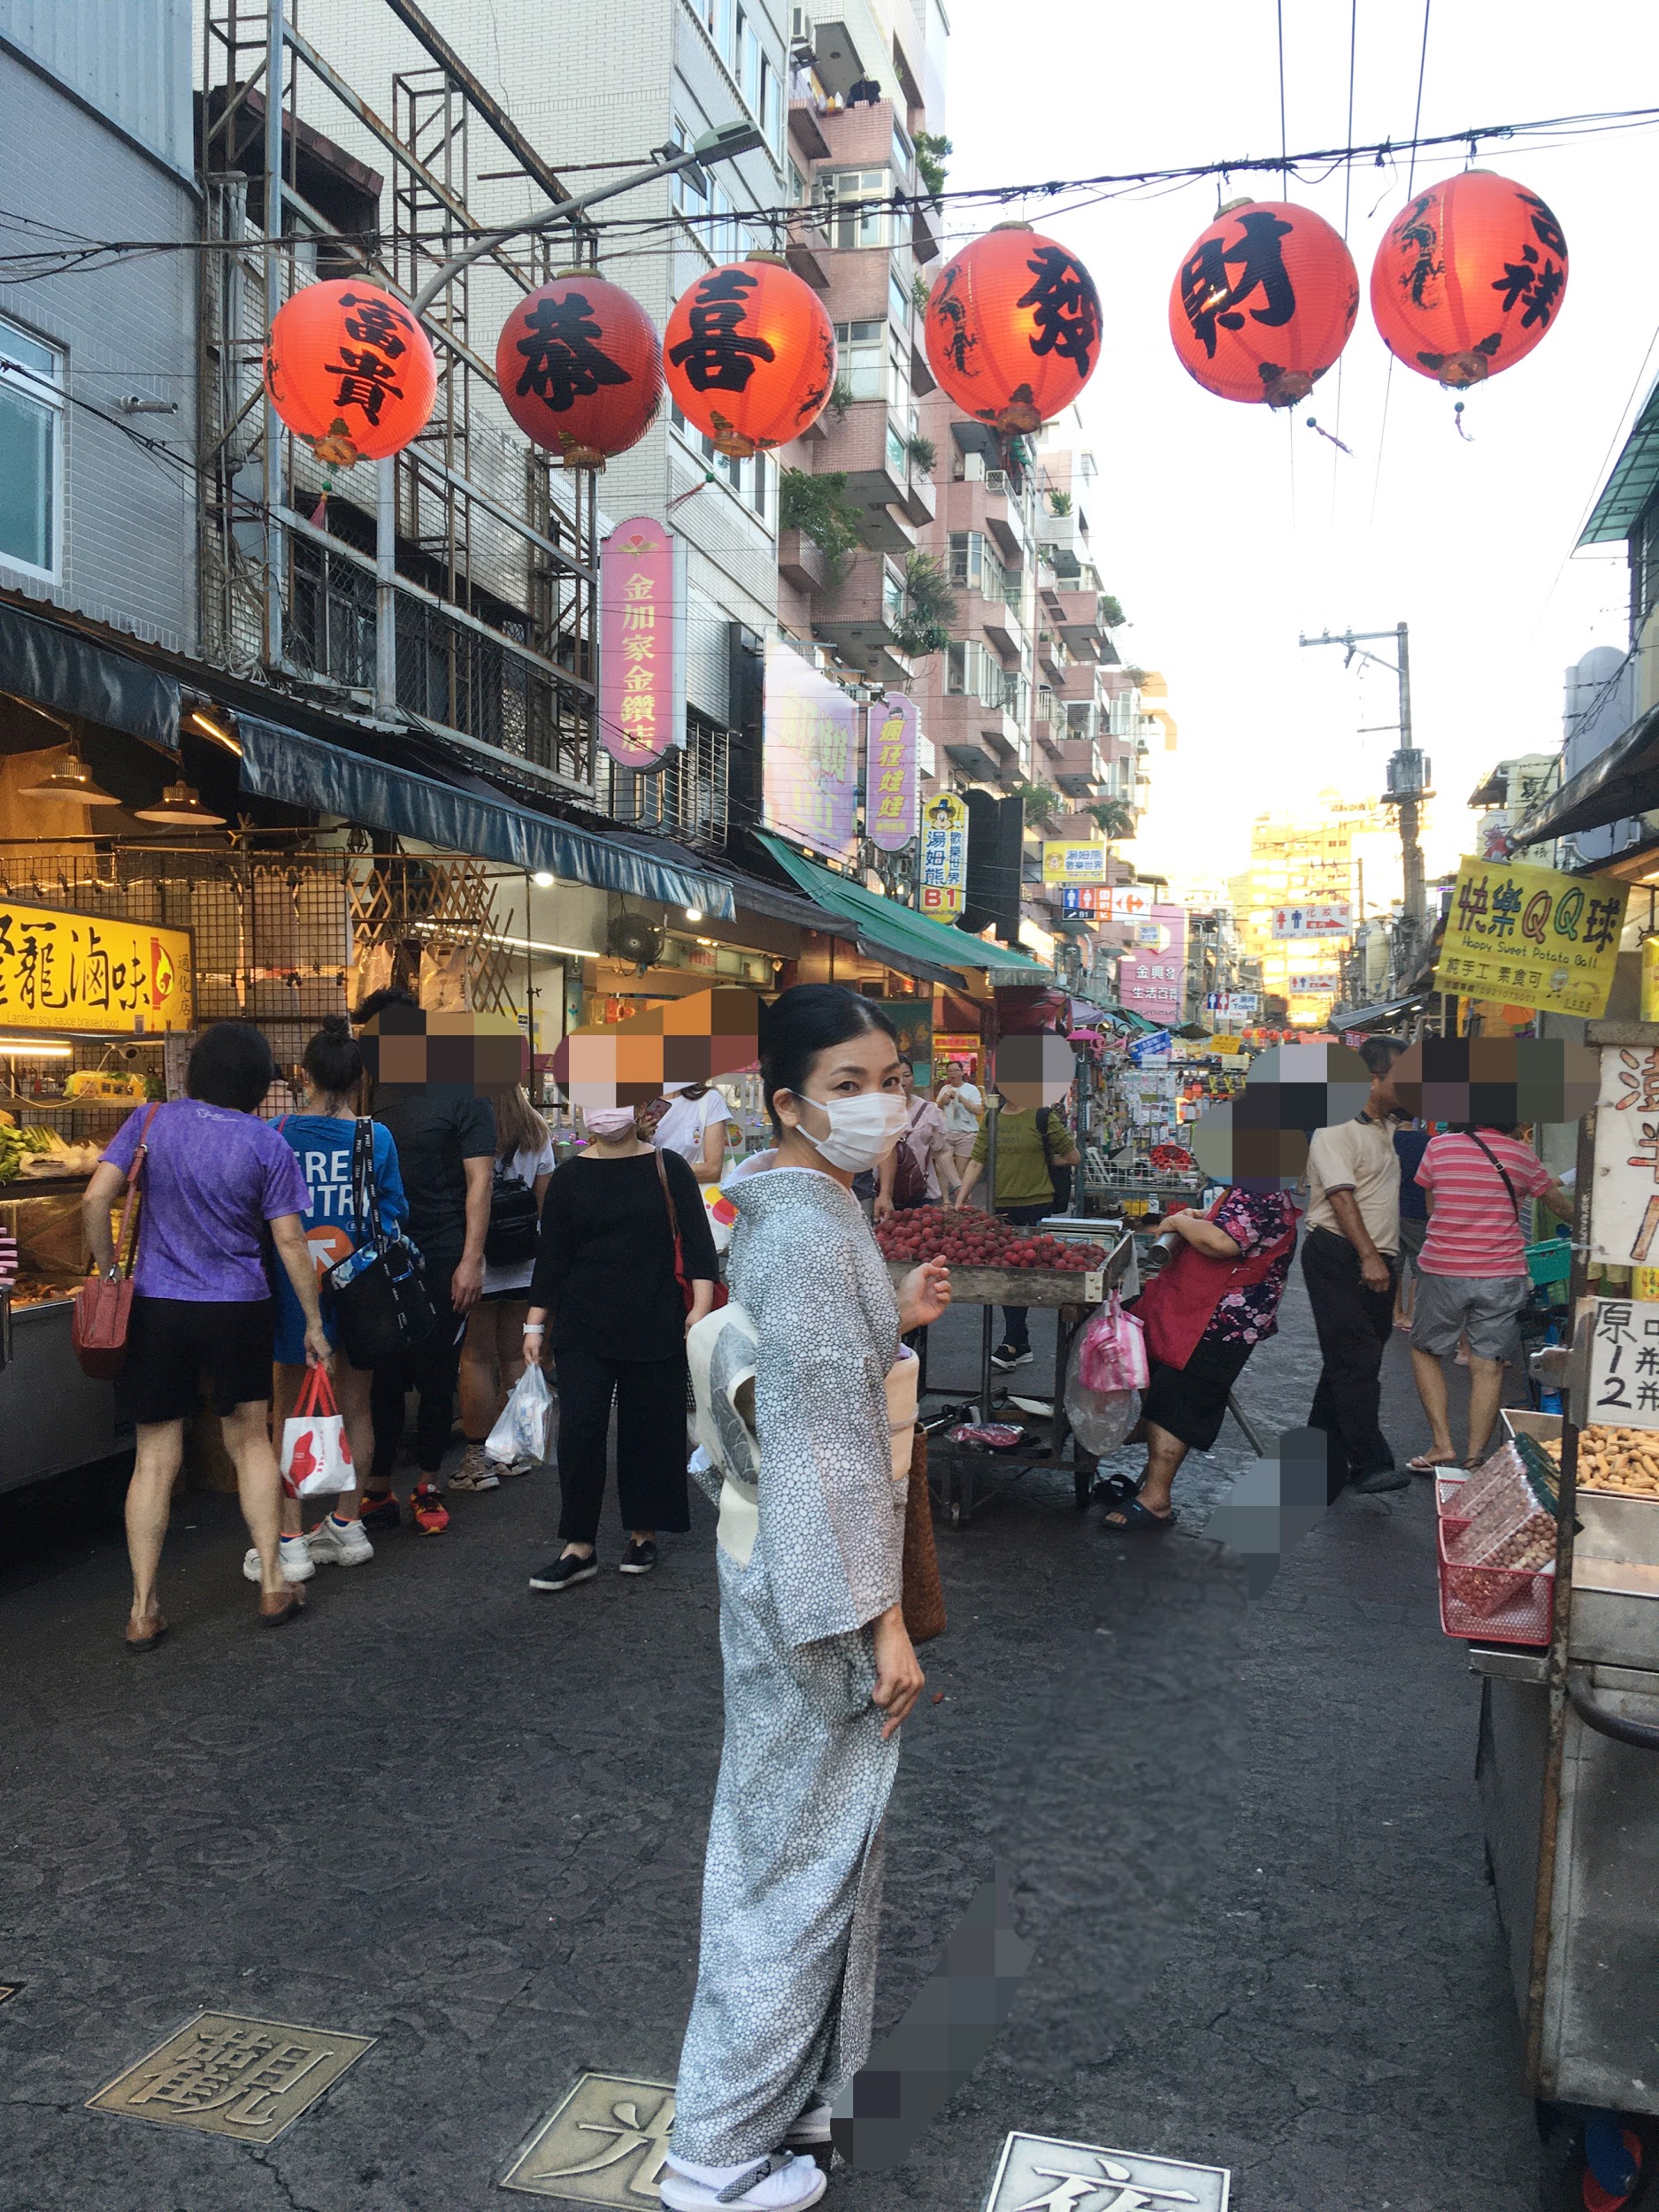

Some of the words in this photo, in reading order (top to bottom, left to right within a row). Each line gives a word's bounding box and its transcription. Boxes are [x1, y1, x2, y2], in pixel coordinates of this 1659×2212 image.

[1181, 211, 1294, 360] 財
[1492, 192, 1569, 330] 吉祥
[516, 292, 634, 412] 恭
[668, 269, 776, 394] 喜
[1016, 245, 1103, 380] 發
[324, 292, 415, 427] 富貴
[619, 572, 657, 753] 金加家金鑽店
[877, 718, 907, 818] 瘋狂娃娃
[924, 830, 947, 885] 湯姆熊
[924, 888, 956, 908] B1
[949, 831, 962, 885] 歡樂世界
[1457, 876, 1621, 954] 快樂QQ球
[1463, 935, 1492, 952] Happy
[1497, 941, 1527, 957] Sweet
[1533, 947, 1570, 964] Potato
[1574, 956, 1598, 969] Ball
[177, 954, 192, 1017] 通化店
[1133, 986, 1178, 1001] 生活百貨
[1445, 956, 1491, 979] 純手工
[1497, 965, 1543, 989] 素食可
[7, 1012, 36, 1024] Lantern
[39, 1016, 51, 1027] soy
[54, 1016, 76, 1026] sauce
[78, 1017, 103, 1028] braised
[104, 1019, 119, 1029] food
[128, 2031, 334, 2125] 觀
